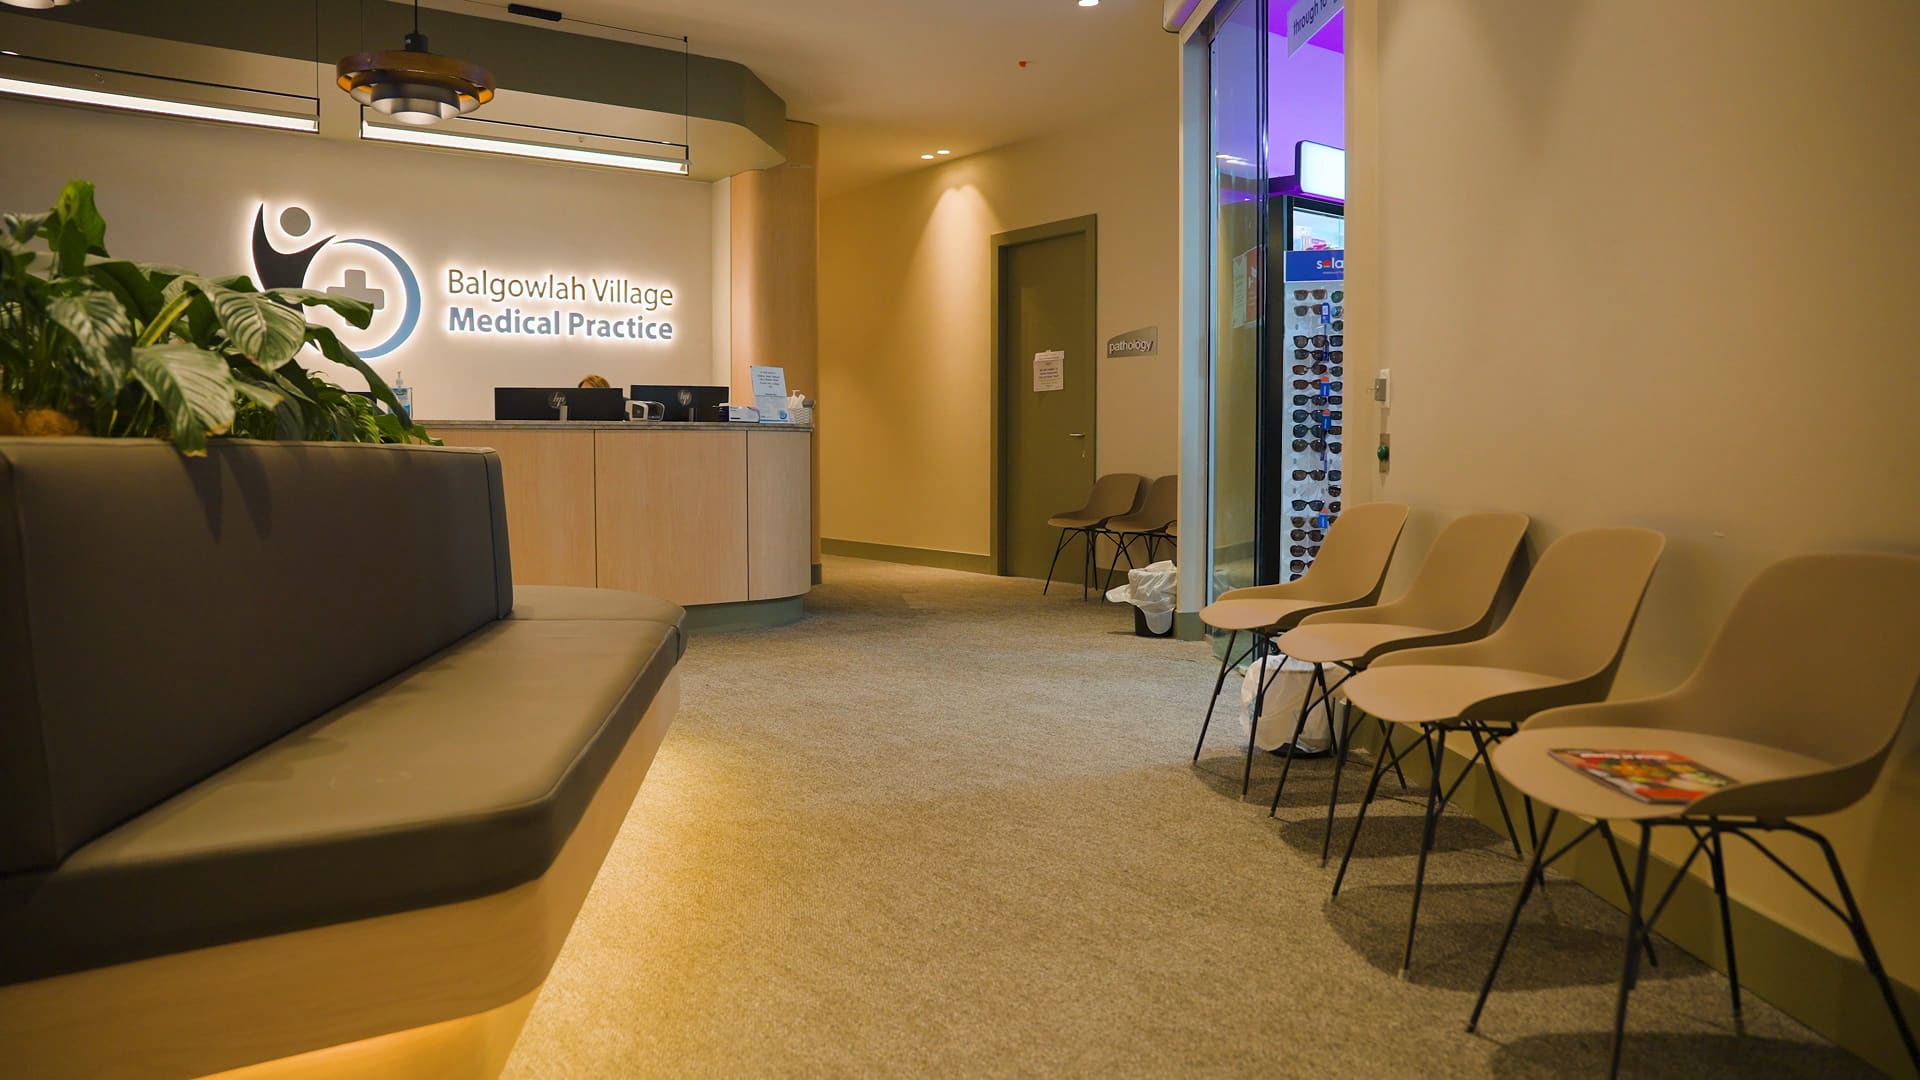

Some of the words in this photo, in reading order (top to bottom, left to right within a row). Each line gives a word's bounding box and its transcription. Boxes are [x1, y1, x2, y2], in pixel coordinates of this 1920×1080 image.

[1293, 0, 1319, 36] through
[448, 269, 586, 303] Balgowlah
[592, 278, 674, 311] Village
[449, 306, 560, 335] Medical
[568, 312, 673, 340] Practice
[1109, 340, 1154, 355] pathology
